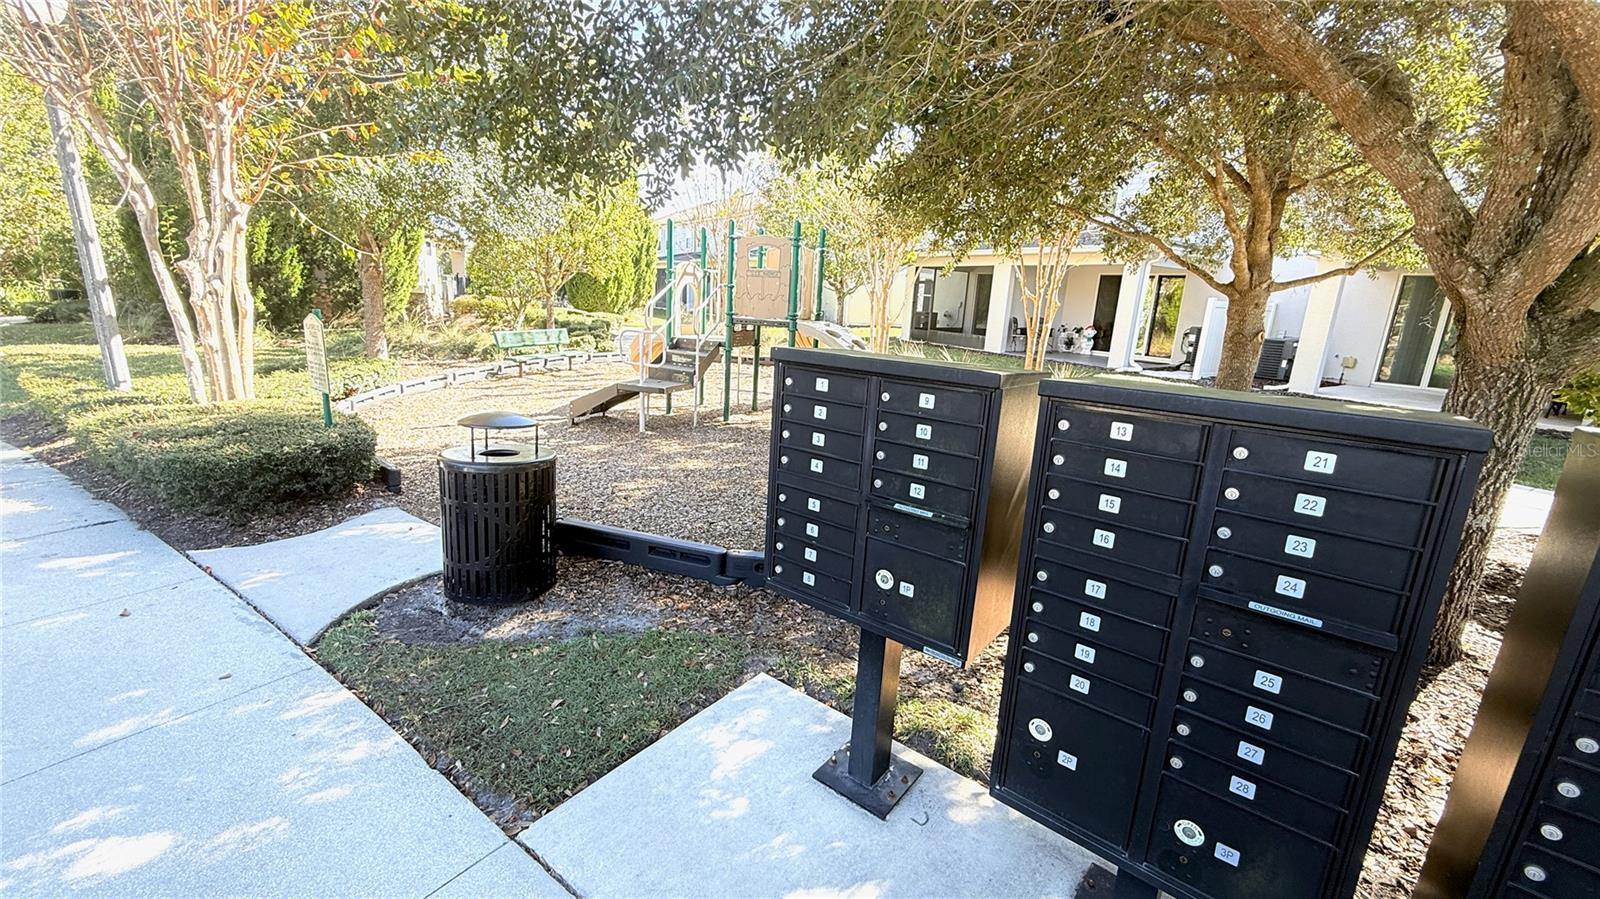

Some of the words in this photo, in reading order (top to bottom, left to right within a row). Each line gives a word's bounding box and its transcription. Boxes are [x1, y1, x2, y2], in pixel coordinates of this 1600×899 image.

[920, 427, 928, 437] 10
[1116, 426, 1128, 437] 13
[917, 457, 925, 466] 11
[1111, 462, 1121, 473] 14
[1312, 456, 1329, 469] 21
[913, 487, 922, 496] 12
[1105, 498, 1116, 510] 15
[1301, 498, 1319, 512] 22
[1099, 533, 1110, 545] 16
[1292, 540, 1308, 553] 23
[903, 585, 911, 593] 1P
[1091, 584, 1101, 594] 17
[1282, 580, 1298, 593] 24
[1254, 603, 1296, 619] OUTGOING
[1297, 615, 1316, 625] MAIL
[1086, 616, 1096, 628] 18
[1080, 648, 1091, 659] 19
[1074, 678, 1086, 690] 20
[1260, 675, 1275, 688] 25
[1251, 711, 1267, 724] 26
[1243, 746, 1259, 758] 27
[1061, 754, 1073, 765] 2P
[1235, 781, 1250, 794] 28
[1220, 847, 1234, 859] 3P
